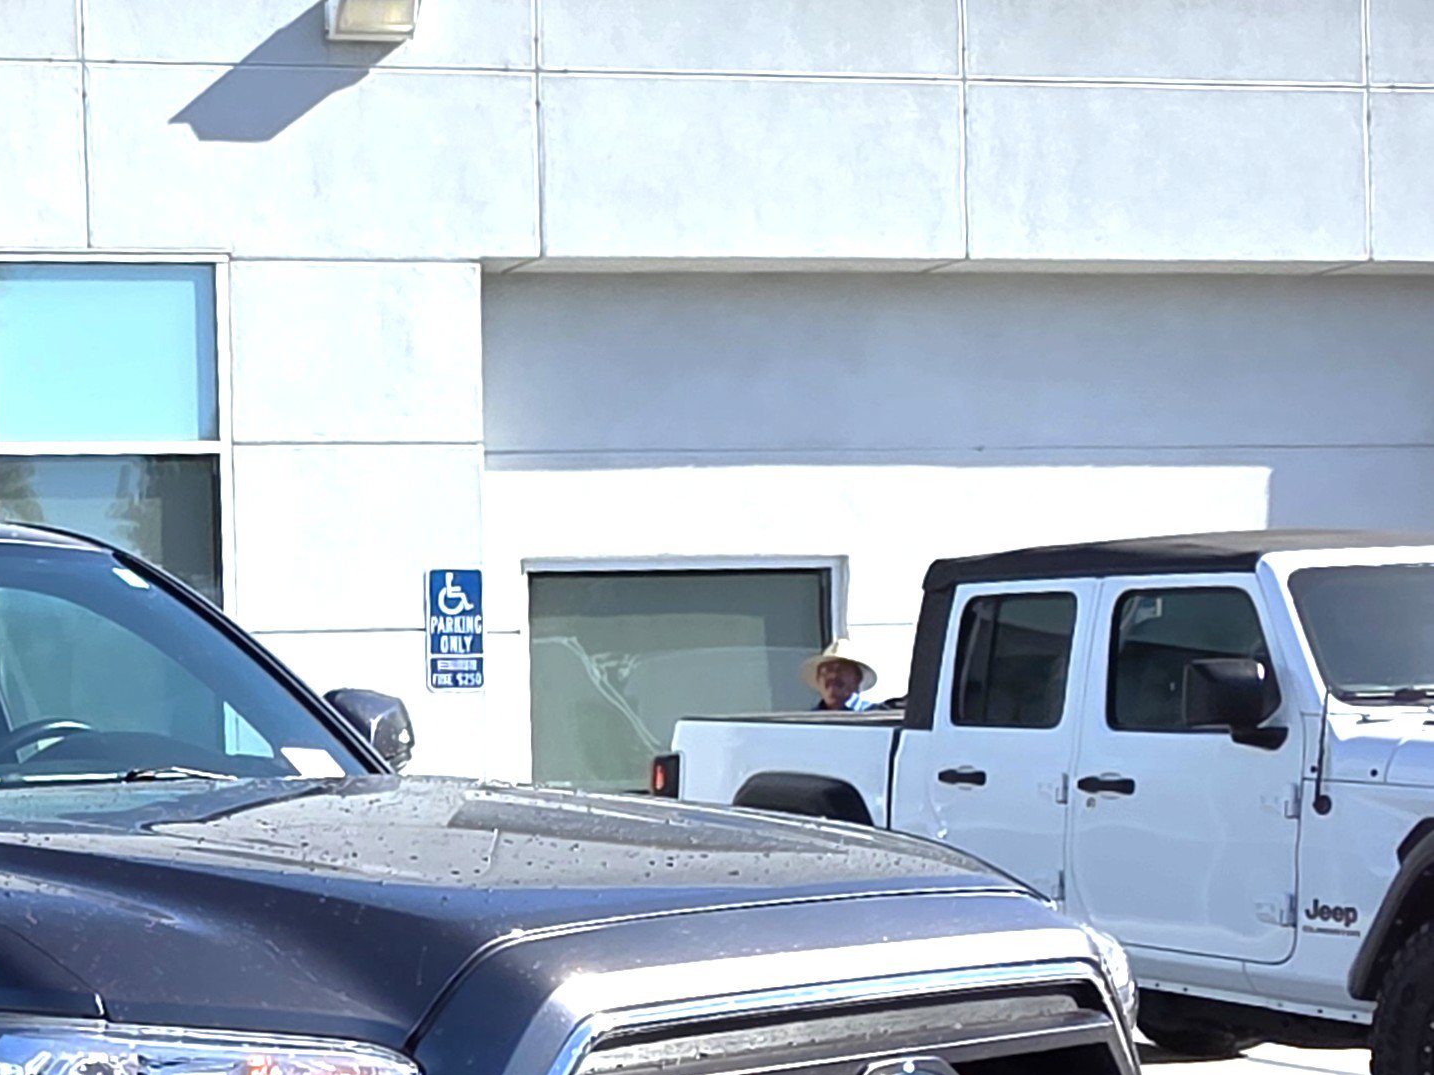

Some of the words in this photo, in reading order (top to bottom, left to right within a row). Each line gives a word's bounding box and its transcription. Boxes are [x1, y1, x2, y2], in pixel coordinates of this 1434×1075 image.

[430, 615, 482, 635] PARKING
[439, 635, 474, 653] ONLY
[1304, 898, 1359, 927] Jeep
